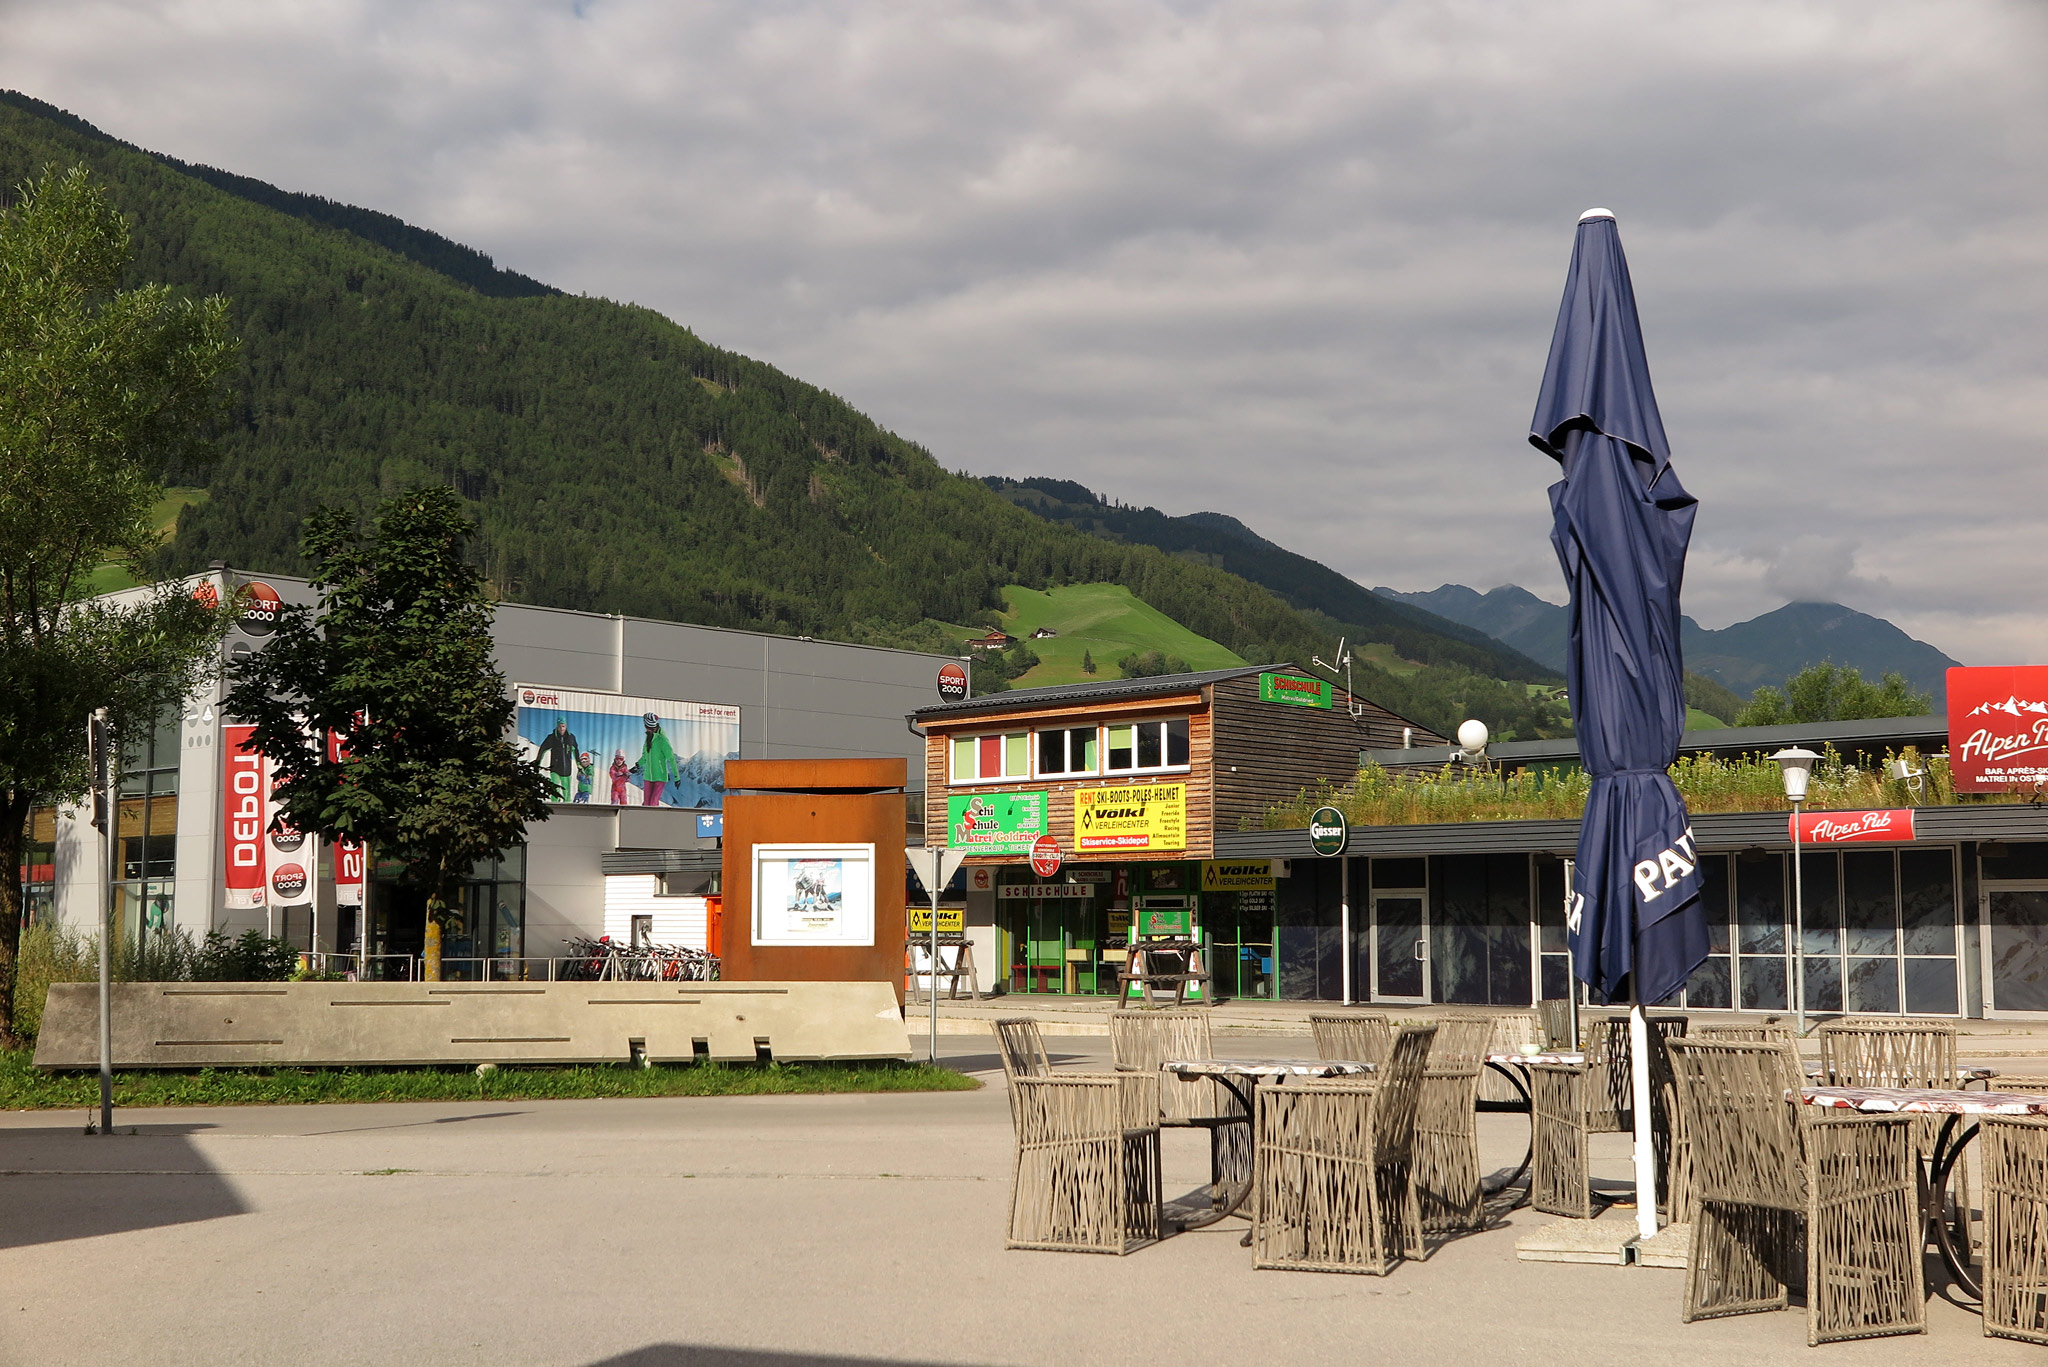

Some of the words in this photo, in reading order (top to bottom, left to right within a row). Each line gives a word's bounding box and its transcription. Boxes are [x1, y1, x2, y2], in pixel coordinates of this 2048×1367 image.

[940, 675, 965, 686] SPORT
[1274, 676, 1321, 696] SCHISCHULE
[941, 684, 963, 694] 2000
[536, 694, 559, 706] rent
[699, 706, 713, 715] best
[714, 708, 723, 717] for
[723, 709, 737, 717] rent
[1960, 728, 2031, 762] Alpen
[1975, 775, 2008, 783] MATREI
[1079, 791, 1096, 805] RENT
[1096, 787, 1179, 804] SKI-BOOTS-POLES-HELMET
[970, 797, 994, 818] Schi
[1095, 807, 1146, 819] Völkl
[964, 811, 999, 830] Schule
[1095, 819, 1150, 830] VERLEIHCENTER
[1809, 819, 1861, 842] Alpen
[1862, 811, 1892, 830] Pub
[955, 823, 1040, 844] Matrei/Goldried
[1311, 822, 1342, 840] Gösser
[1081, 836, 1148, 848] Skiservice-Skidepot
[1163, 839, 1180, 847] Touring
[1219, 865, 1269, 876] Völkl
[1219, 876, 1273, 887] VERLEIHCENTER
[1005, 885, 1087, 897] SCHISCHULE
[922, 912, 958, 920] Vlkl
